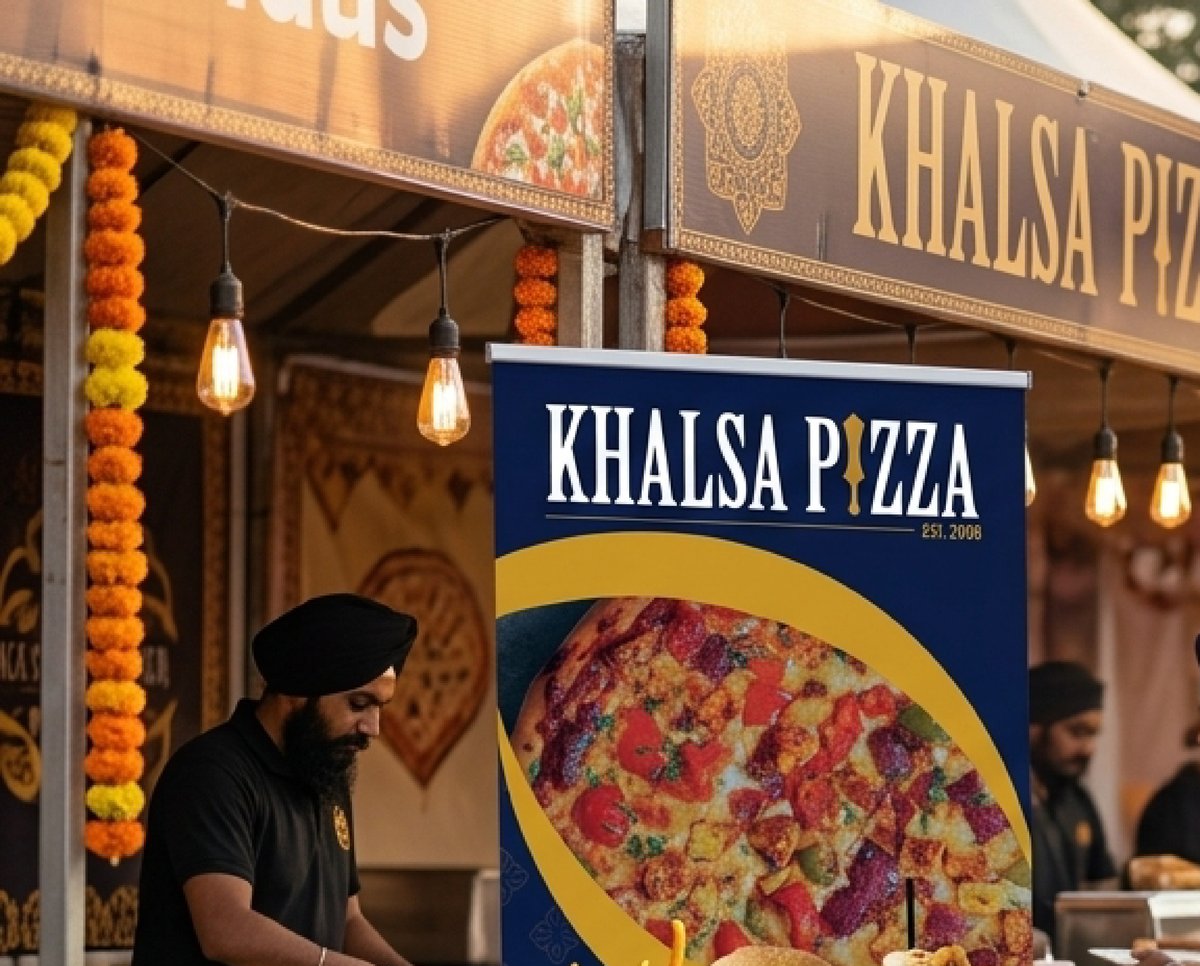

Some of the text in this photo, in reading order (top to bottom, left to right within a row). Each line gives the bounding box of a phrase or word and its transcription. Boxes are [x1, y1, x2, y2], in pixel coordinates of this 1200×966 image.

[853, 51, 1099, 297] KHALSA
[545, 403, 980, 519] KHALSA PIZZA
